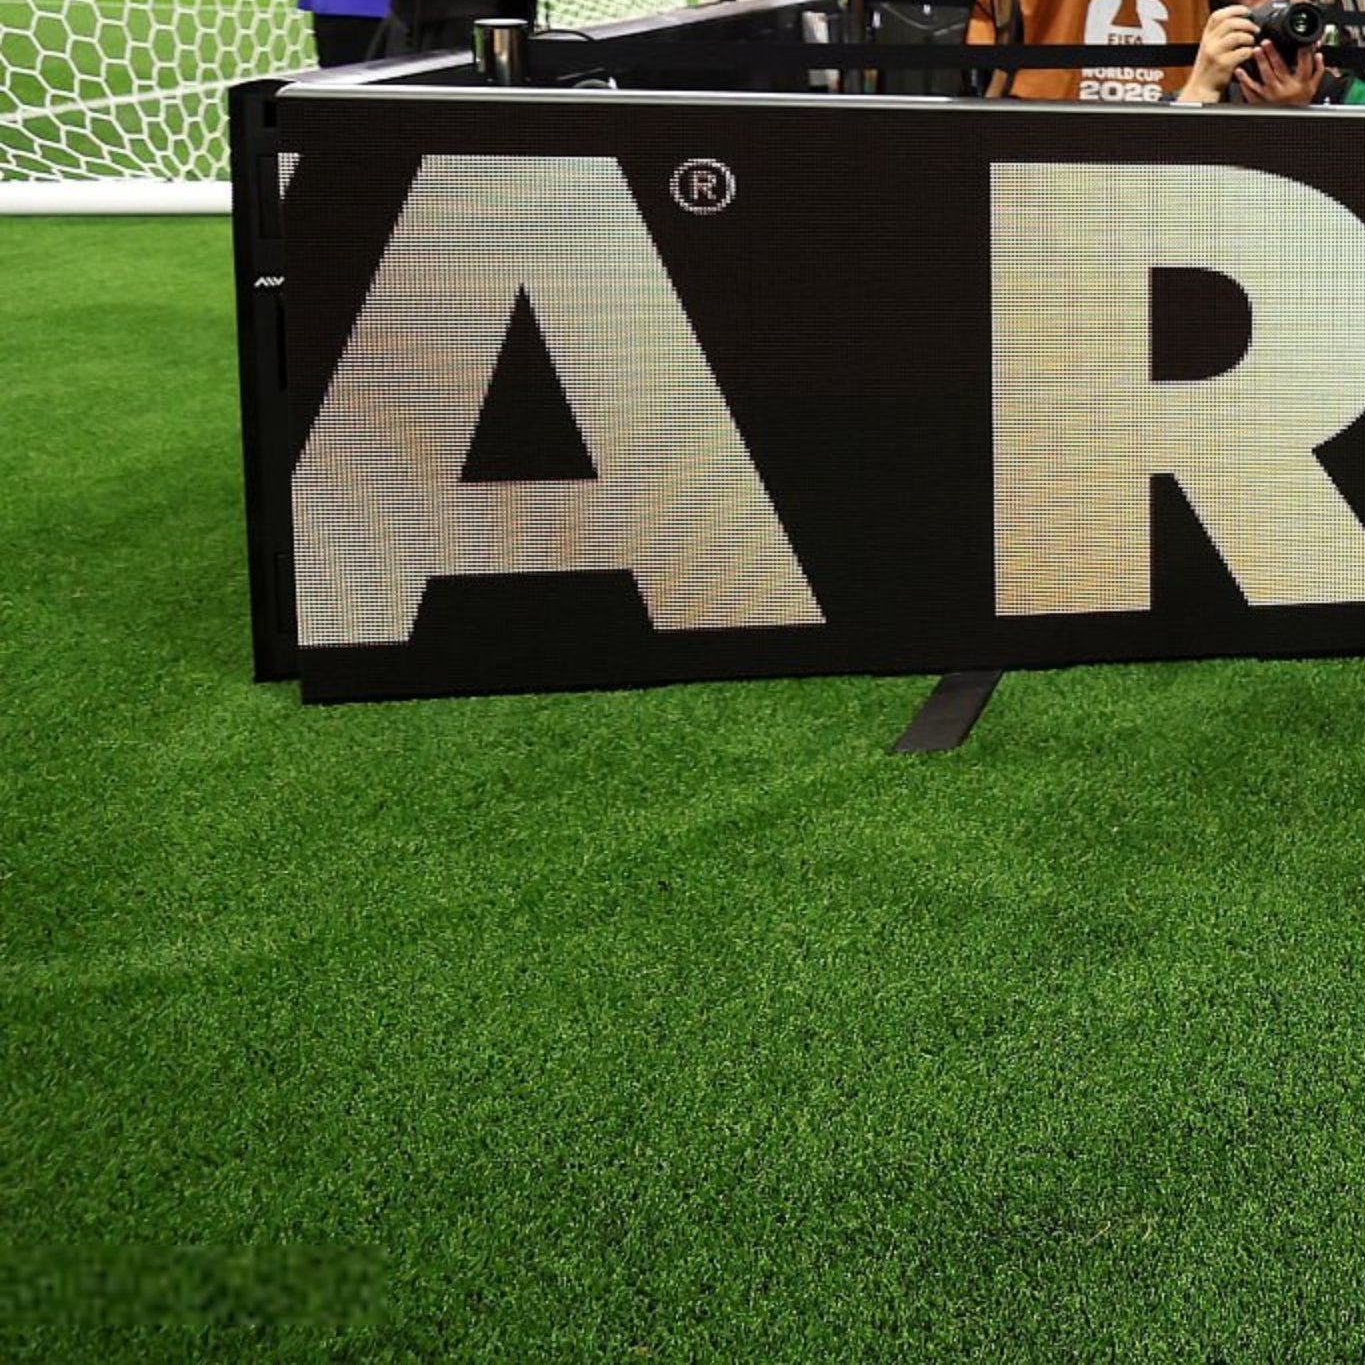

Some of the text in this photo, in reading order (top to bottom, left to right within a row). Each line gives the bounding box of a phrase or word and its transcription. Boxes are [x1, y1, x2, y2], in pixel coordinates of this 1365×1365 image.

[1081, 66, 1165, 82] WORLD CUP
[1079, 80, 1163, 102] 2026
